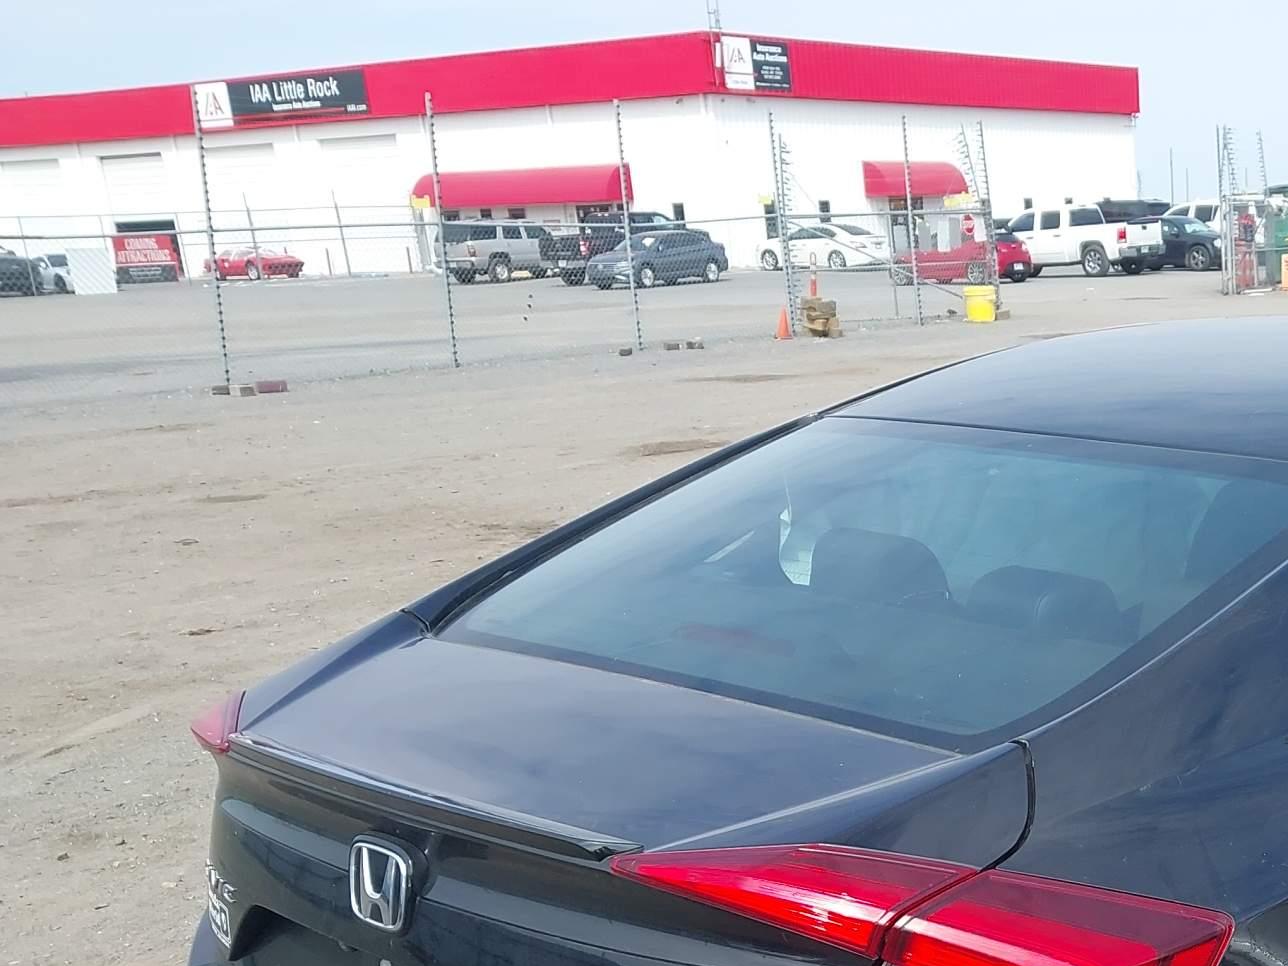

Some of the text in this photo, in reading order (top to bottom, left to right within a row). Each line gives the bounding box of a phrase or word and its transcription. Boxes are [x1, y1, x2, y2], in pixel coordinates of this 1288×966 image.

[249, 76, 340, 103] IAA Little Rock
